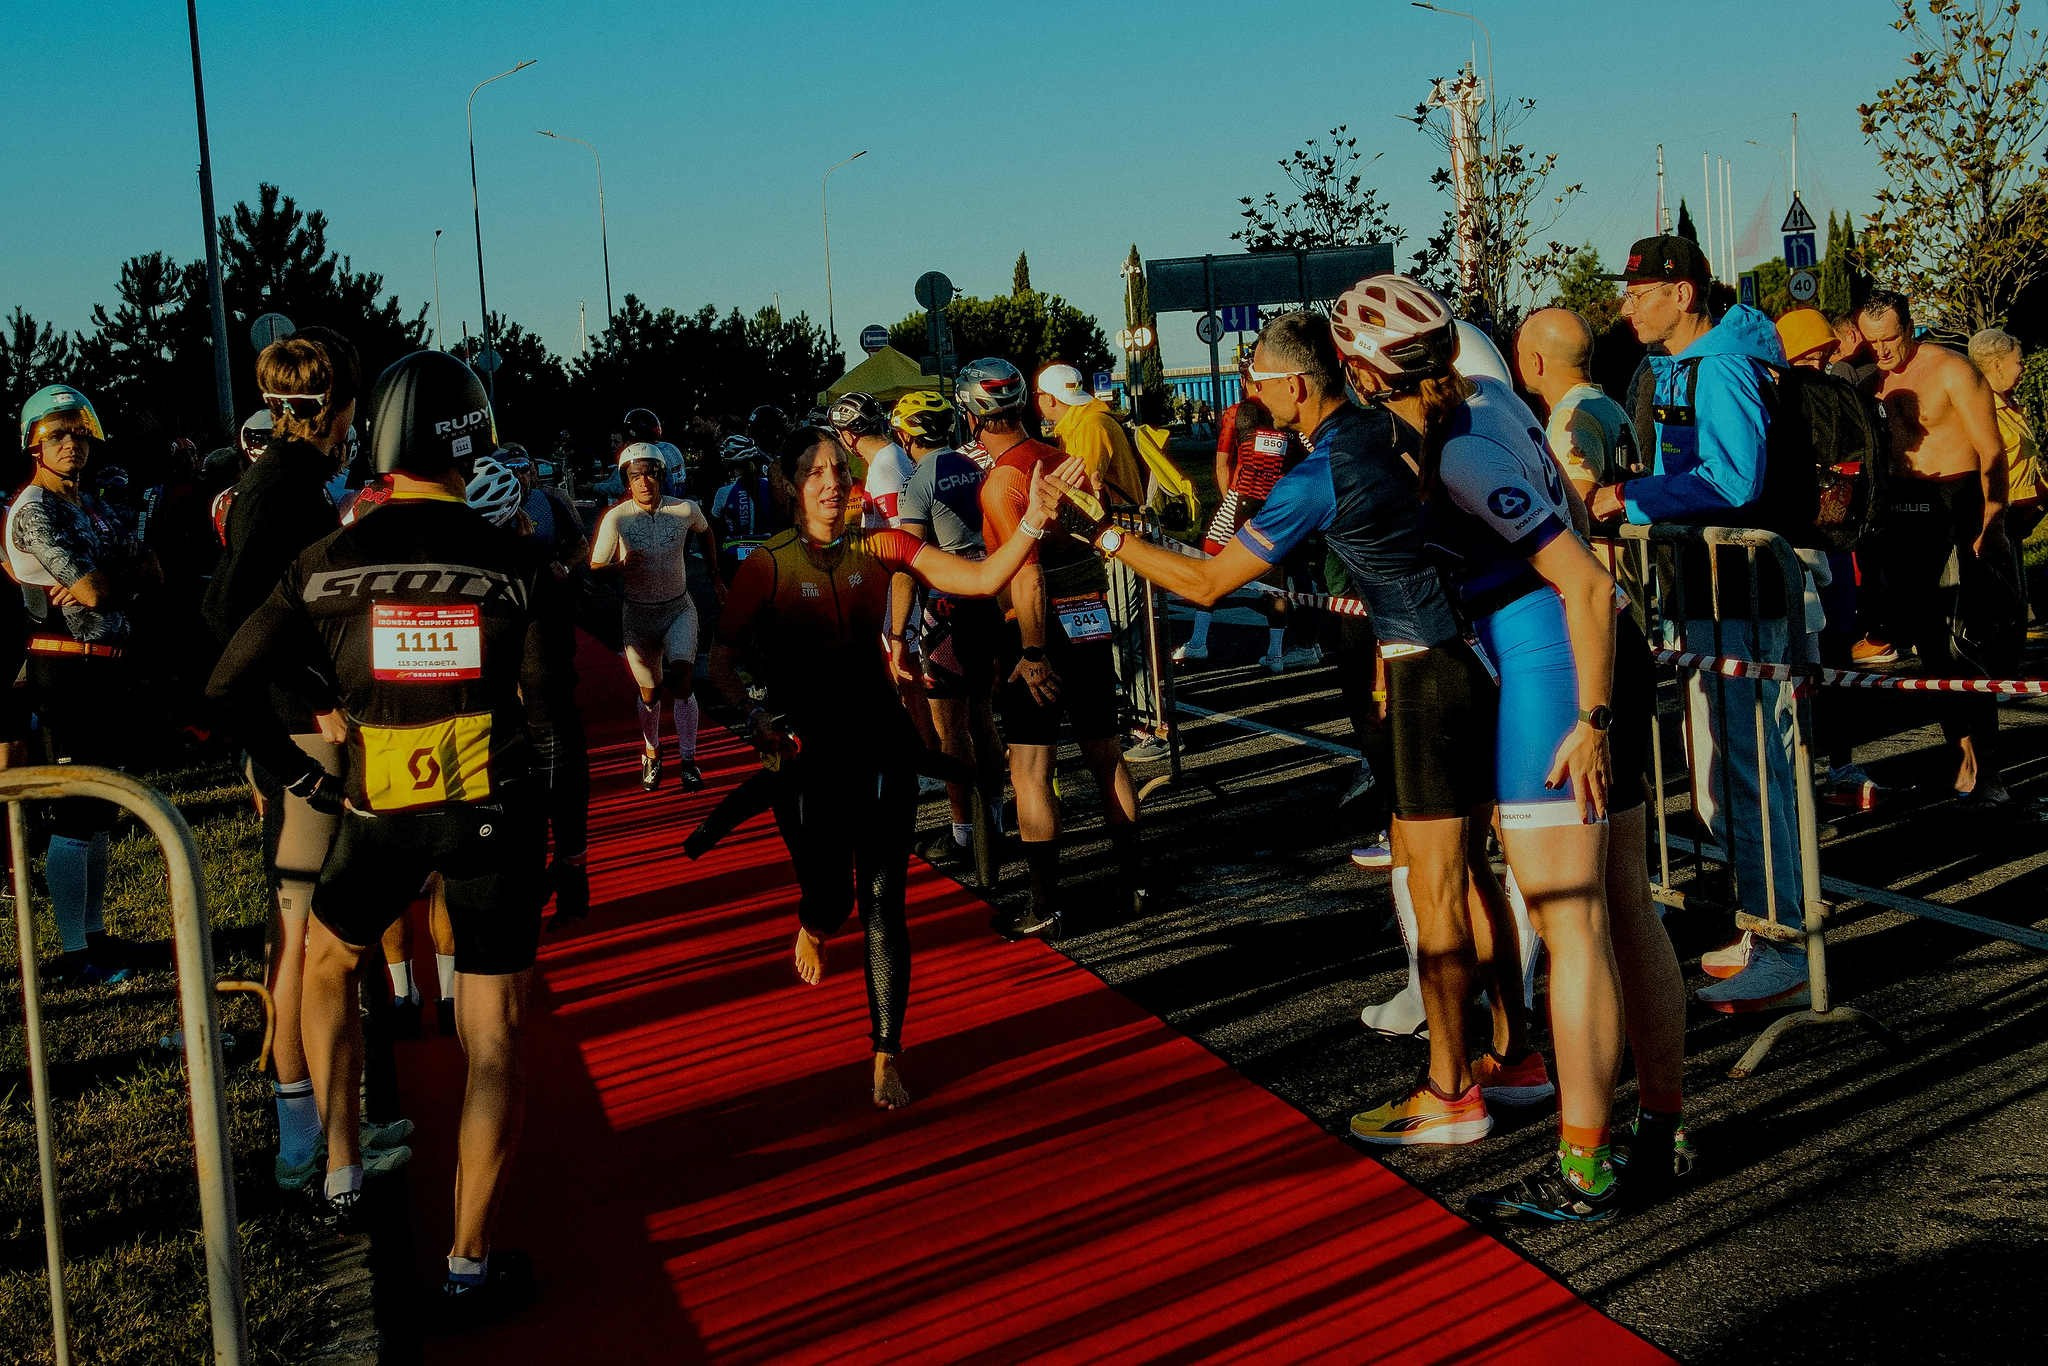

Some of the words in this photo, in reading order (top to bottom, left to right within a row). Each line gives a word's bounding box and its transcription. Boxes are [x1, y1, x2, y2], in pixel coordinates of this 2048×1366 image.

[1793, 280, 1811, 291] 40
[1099, 375, 1109, 389] P
[1263, 439, 1282, 448] 850
[937, 471, 984, 491] CRAFT
[1514, 506, 1545, 531] ROSATOM
[305, 564, 503, 601] SCOTT
[377, 619, 417, 627] IRONSTAR
[418, 619, 452, 627] СИРИУС
[1072, 612, 1100, 627] 841
[396, 632, 458, 652] 1111
